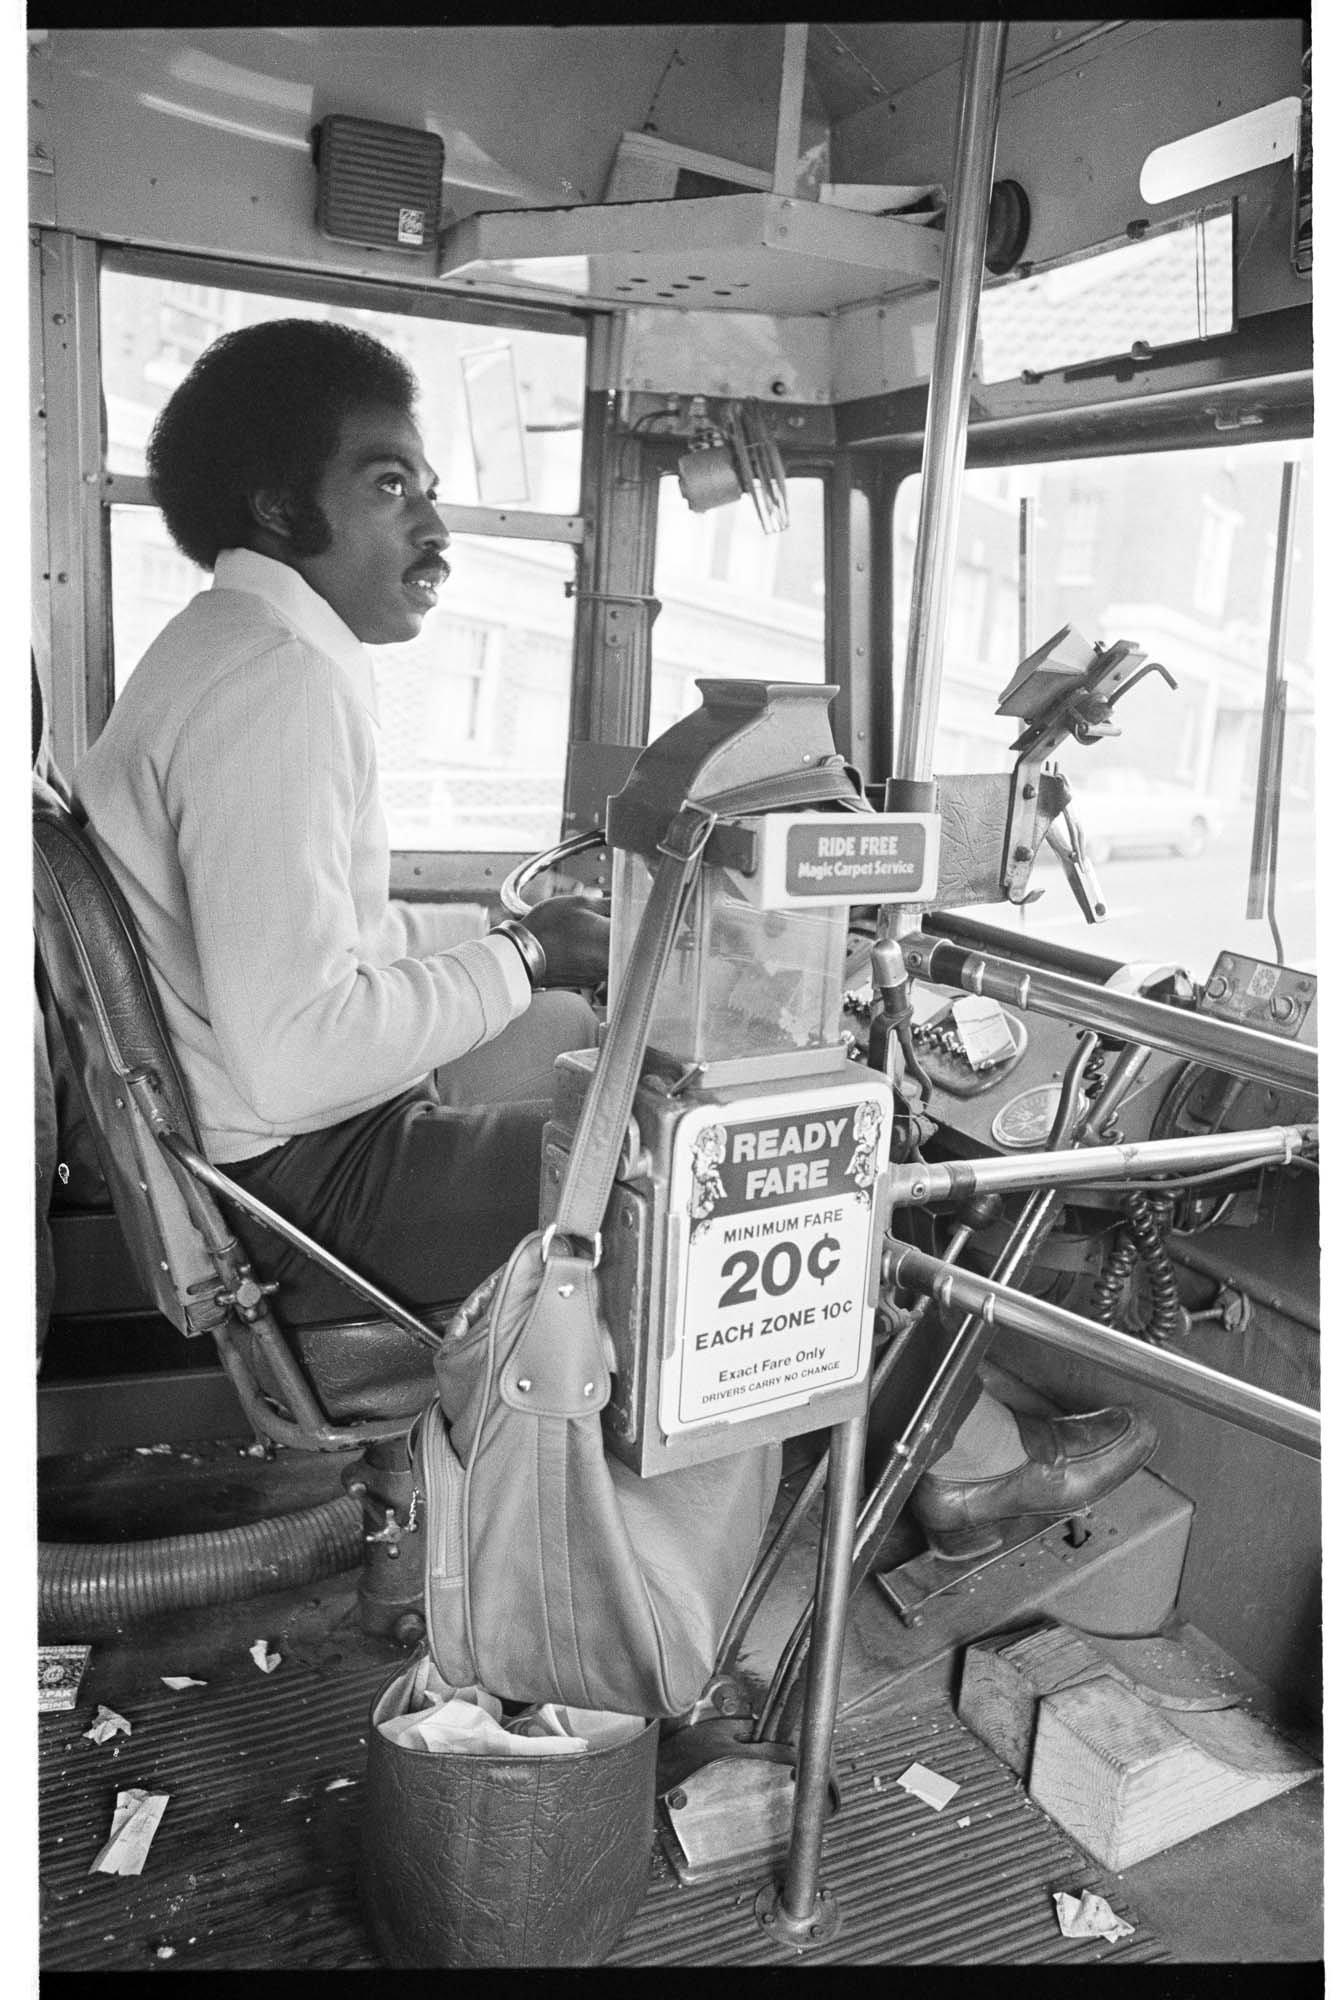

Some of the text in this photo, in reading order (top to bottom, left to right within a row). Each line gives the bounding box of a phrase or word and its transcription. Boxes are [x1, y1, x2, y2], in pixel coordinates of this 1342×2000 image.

[818, 836, 898, 857] RIDE FREE
[798, 860, 914, 880] Magic Carpet Service
[732, 1118, 848, 1163] READY
[745, 1159, 830, 1200] FARE
[723, 1209, 844, 1243] MINIMUM FARE
[718, 1233, 841, 1309] 20¢
[695, 1322, 754, 1351] EACH
[760, 1308, 816, 1336] ZONE
[702, 1361, 841, 1404] DRIVERS CARRY NO CHANGE
[718, 1347, 826, 1383] Exact Fare Only
